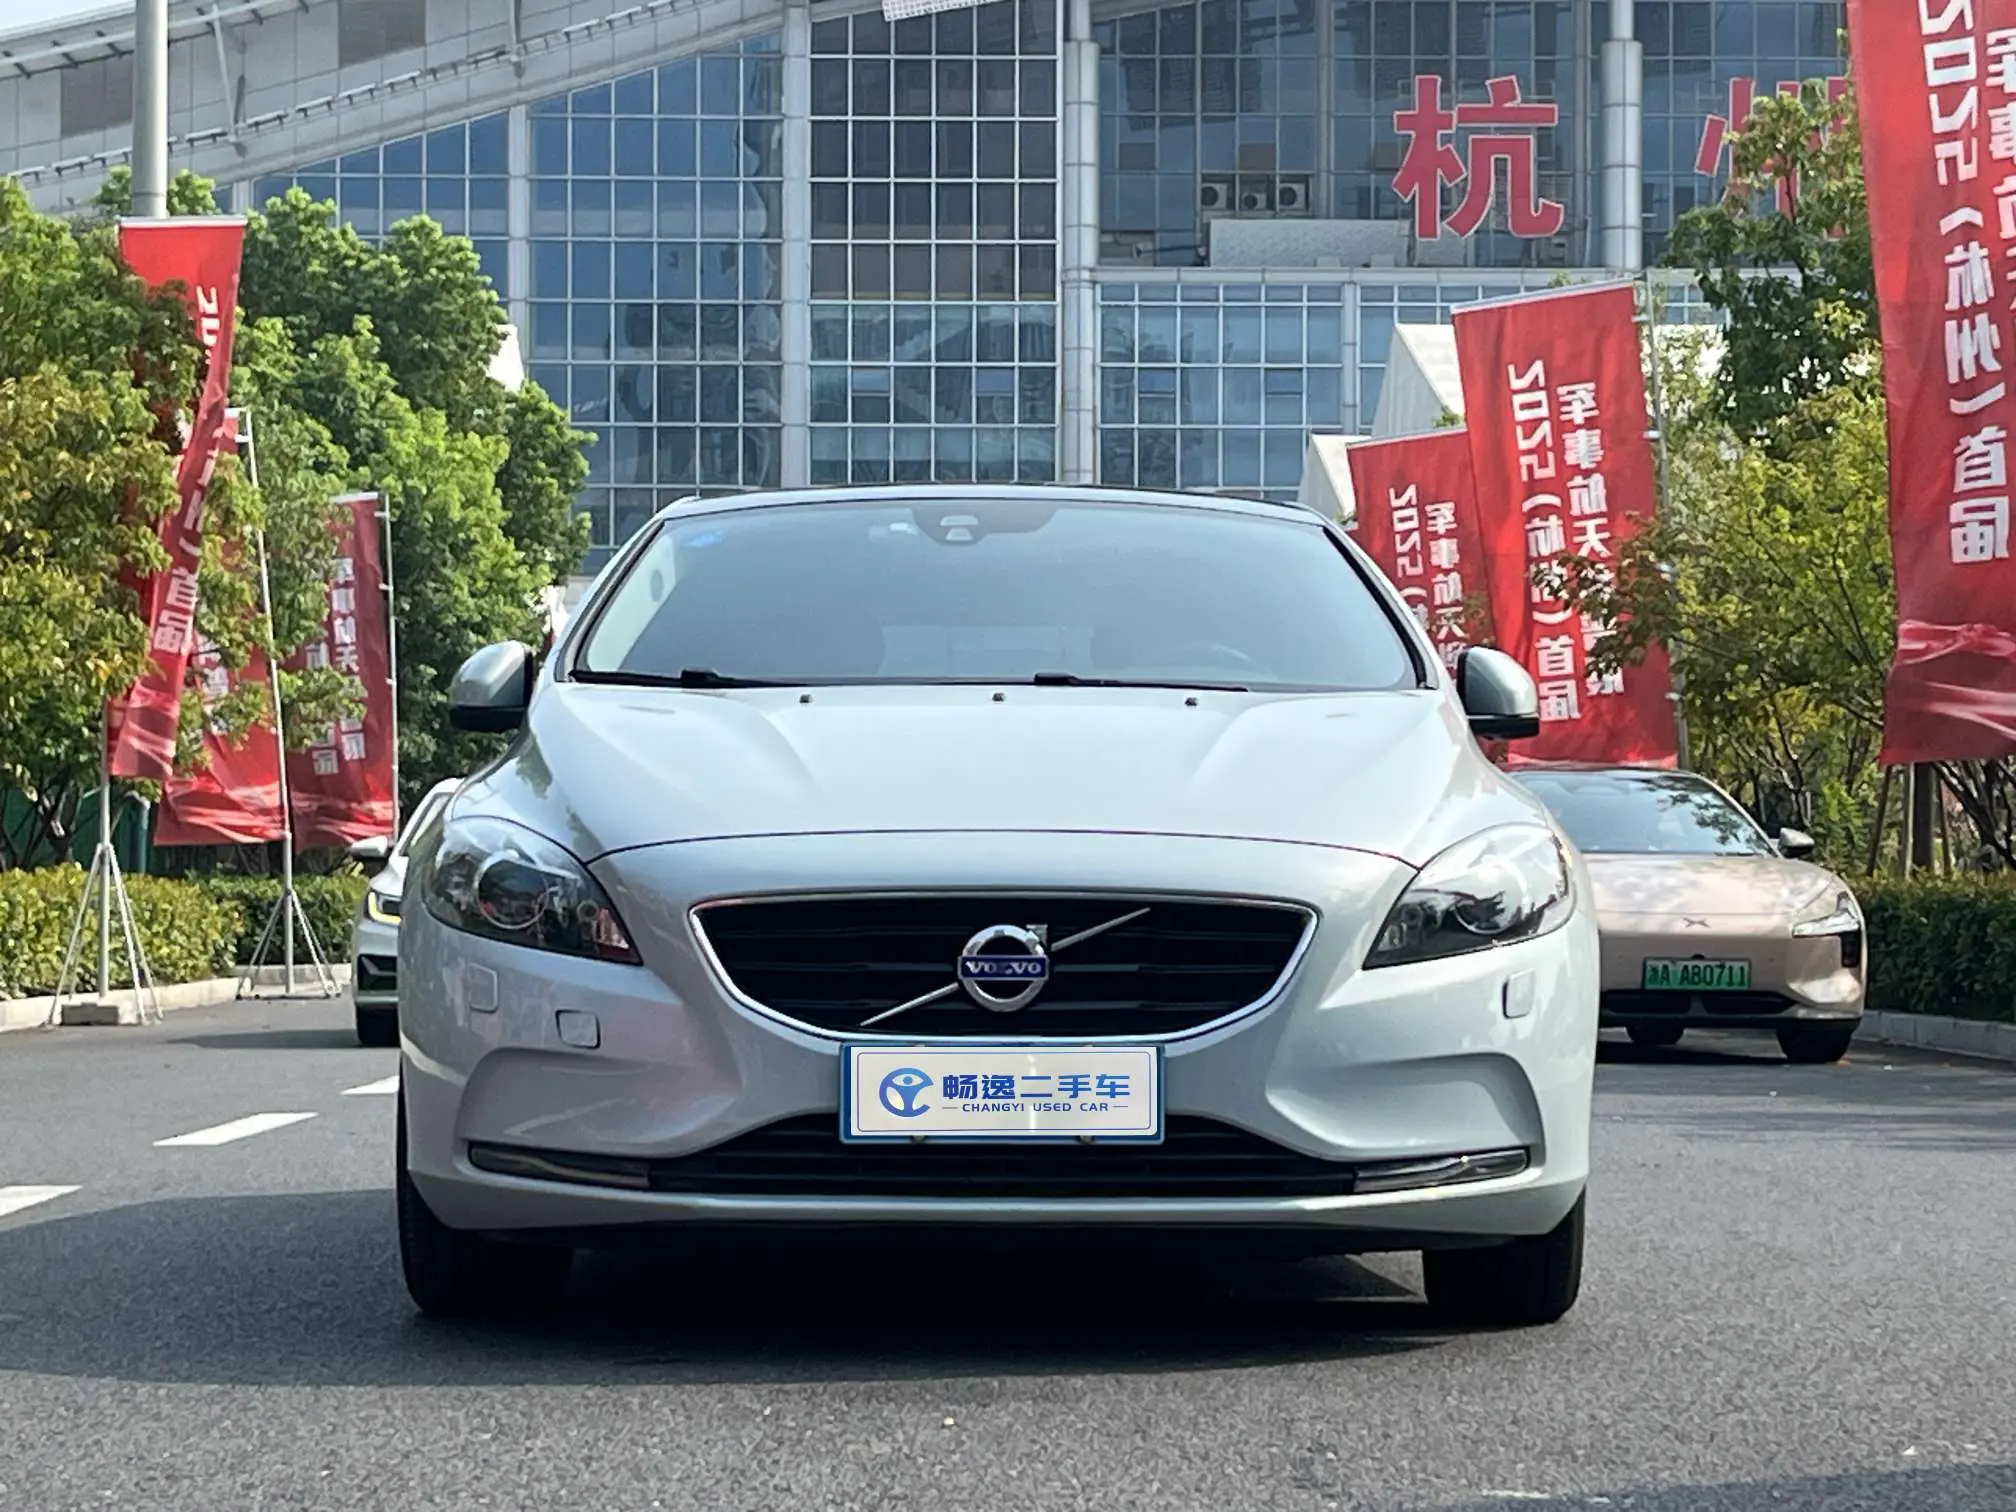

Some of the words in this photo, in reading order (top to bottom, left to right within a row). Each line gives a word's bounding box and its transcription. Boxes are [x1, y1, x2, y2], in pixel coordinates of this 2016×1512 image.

[942, 1074, 1130, 1100] 畅逸二手车
[962, 1102, 1025, 1112] CHANGYI
[1033, 1102, 1072, 1112] USED
[1079, 1102, 1109, 1112] CAR
